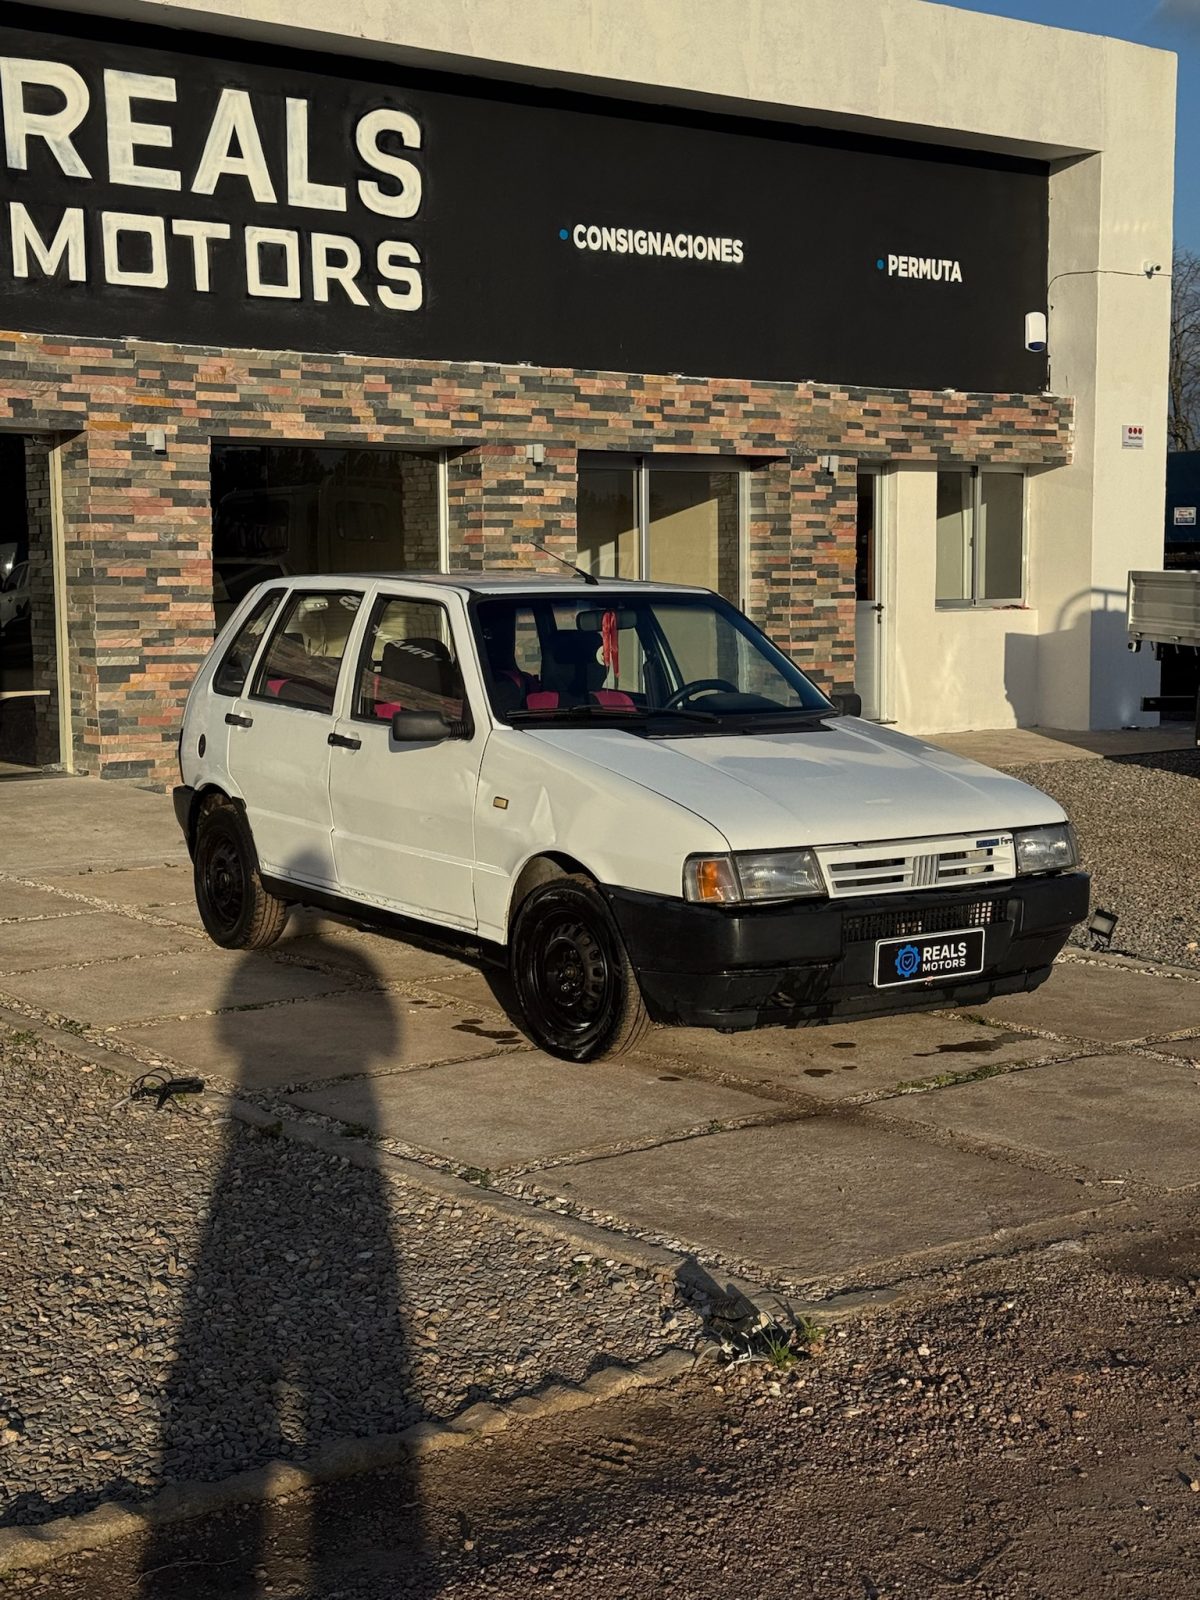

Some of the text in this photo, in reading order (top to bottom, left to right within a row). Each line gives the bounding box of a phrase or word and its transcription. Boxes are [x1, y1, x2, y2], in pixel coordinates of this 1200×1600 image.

[0, 56, 423, 218] REALS
[9, 202, 423, 312] MOTORS
[573, 224, 744, 263] CONSIGNACIONES
[888, 254, 963, 283] PERMUTA
[922, 958, 966, 972] MOTORS
[923, 942, 967, 962] REALS
